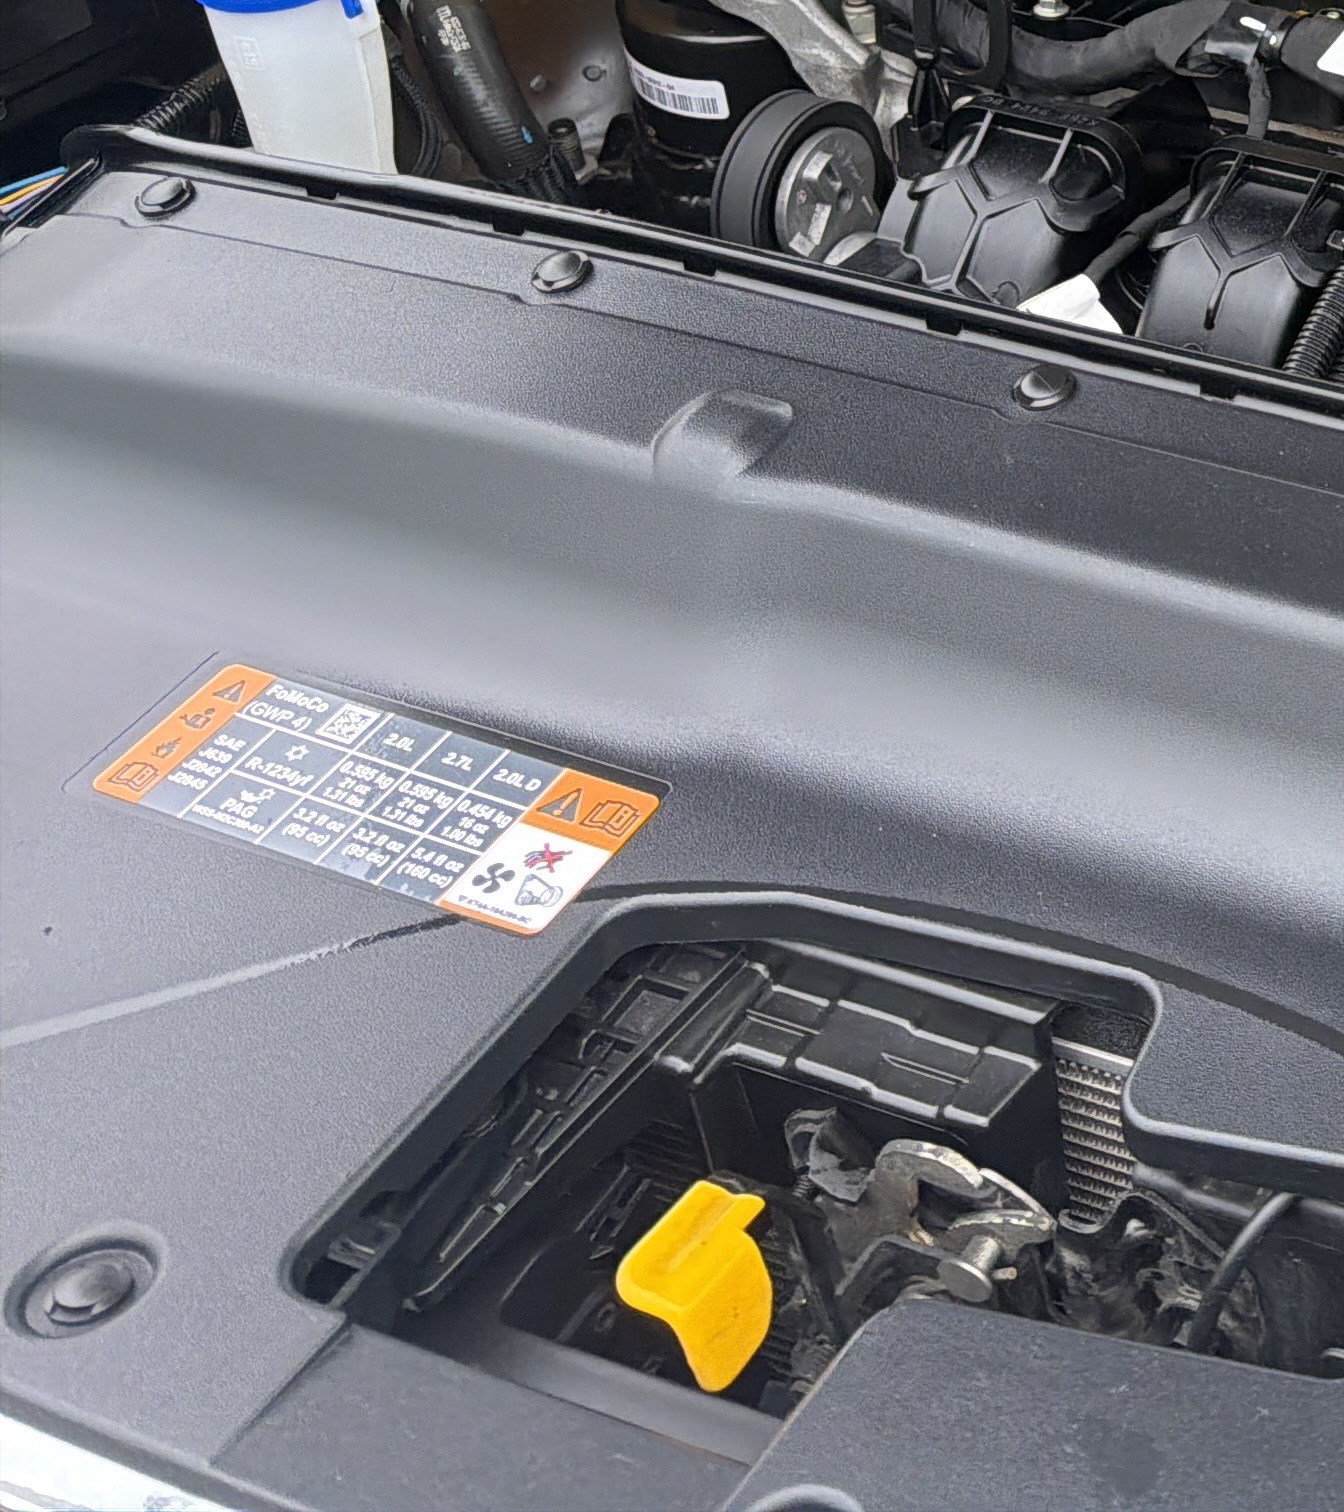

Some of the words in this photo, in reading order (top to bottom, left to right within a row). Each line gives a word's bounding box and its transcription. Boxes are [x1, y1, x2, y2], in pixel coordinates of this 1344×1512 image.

[266, 685, 329, 713] FoMoCo
[242, 701, 292, 728] (GWP
[290, 713, 312, 732] 4)
[214, 734, 246, 751] SAE
[383, 733, 416, 753] 2.0L
[244, 756, 314, 787] R-1234yf
[441, 752, 477, 772] 2.7L
[338, 777, 354, 791] 21
[340, 761, 375, 784] 0.595
[373, 769, 395, 790] kg
[492, 768, 525, 789] 2.0L
[524, 778, 542, 792] D
[322, 787, 347, 802] 1.31
[397, 797, 414, 810] 21
[399, 780, 434, 803] 0.595
[433, 790, 455, 810] kg
[220, 798, 258, 819] PAG
[293, 808, 317, 823] 3.2
[382, 807, 406, 822] 1.31
[457, 800, 492, 822] 0.454
[491, 809, 513, 829] kg
[282, 823, 309, 840] (95
[305, 830, 331, 847] cc)
[352, 827, 377, 842] 3.2
[441, 826, 466, 842] 1.00
[341, 843, 369, 859] (95
[366, 850, 391, 868] cc)
[411, 846, 436, 862] 5.4
[428, 871, 453, 889] cc)
